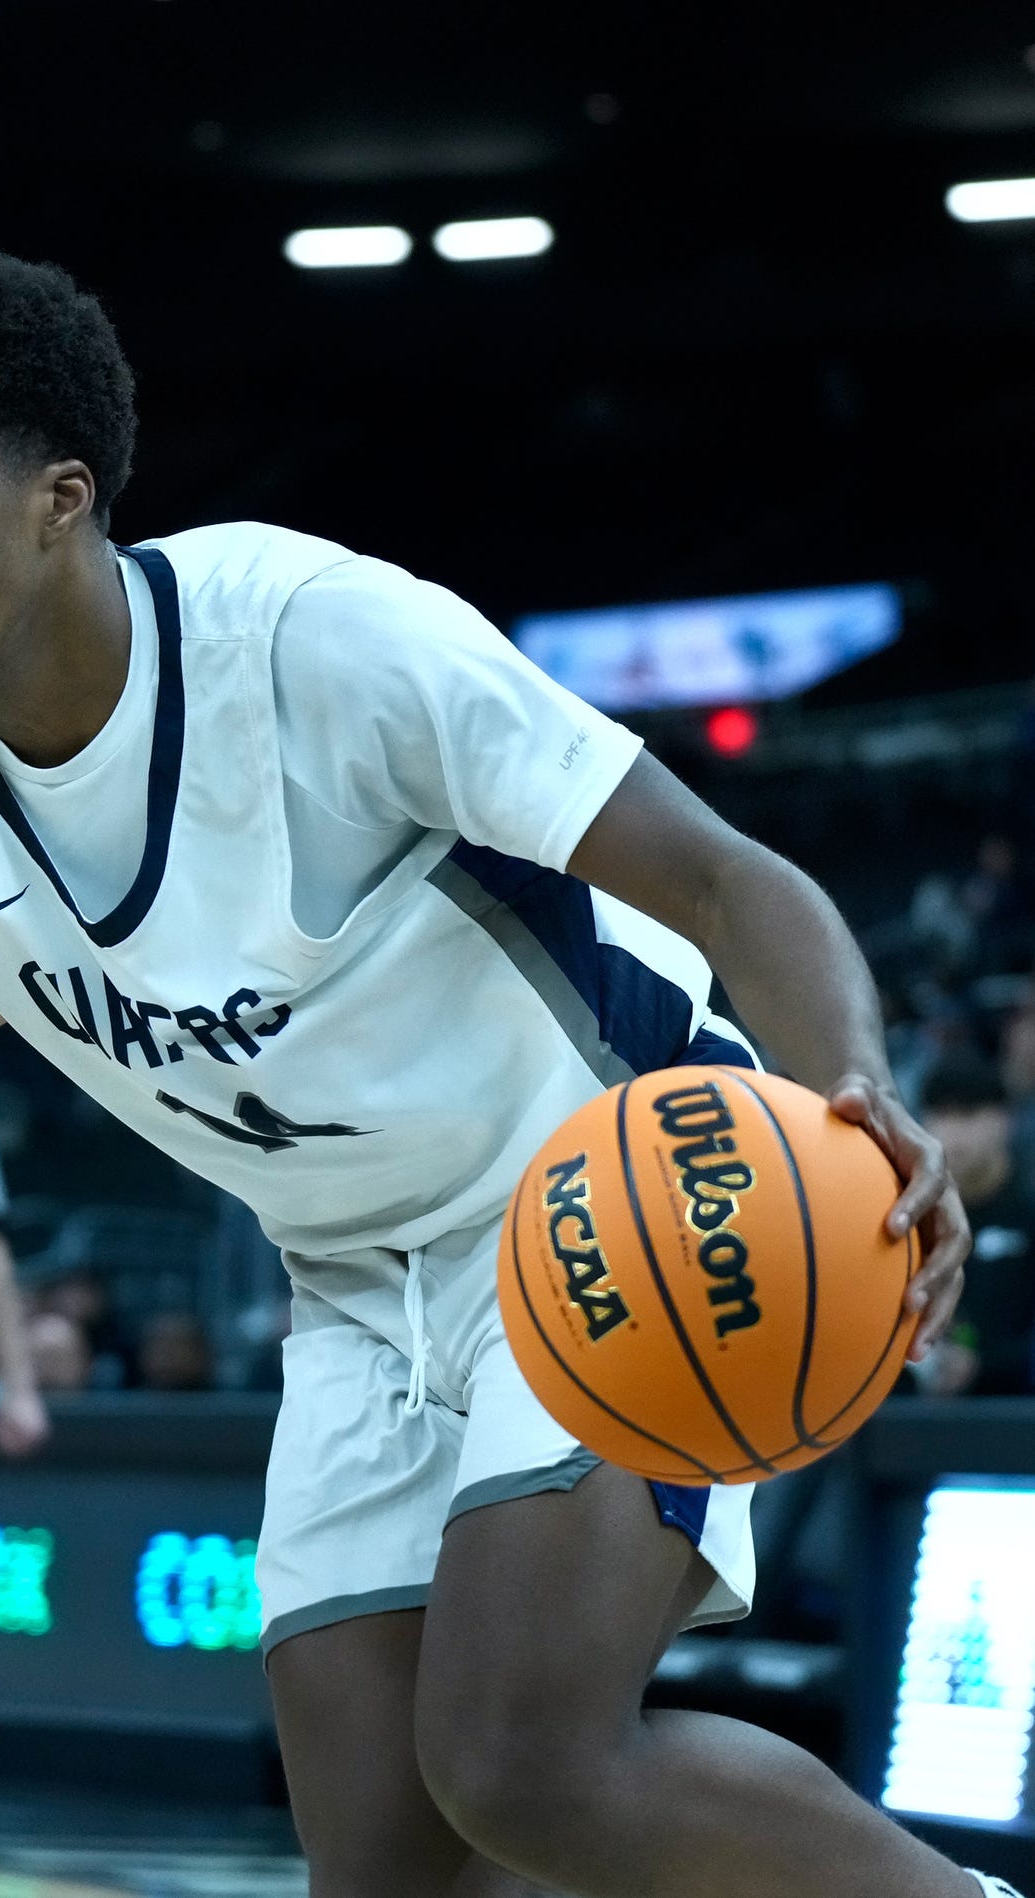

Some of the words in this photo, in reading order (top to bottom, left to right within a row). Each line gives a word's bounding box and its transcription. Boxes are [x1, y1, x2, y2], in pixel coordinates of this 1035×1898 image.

[558, 741, 580, 771] UPF
[576, 726, 591, 743] 40
[541, 1150, 632, 1344] NCAA
[651, 1080, 764, 1341] Wilson
